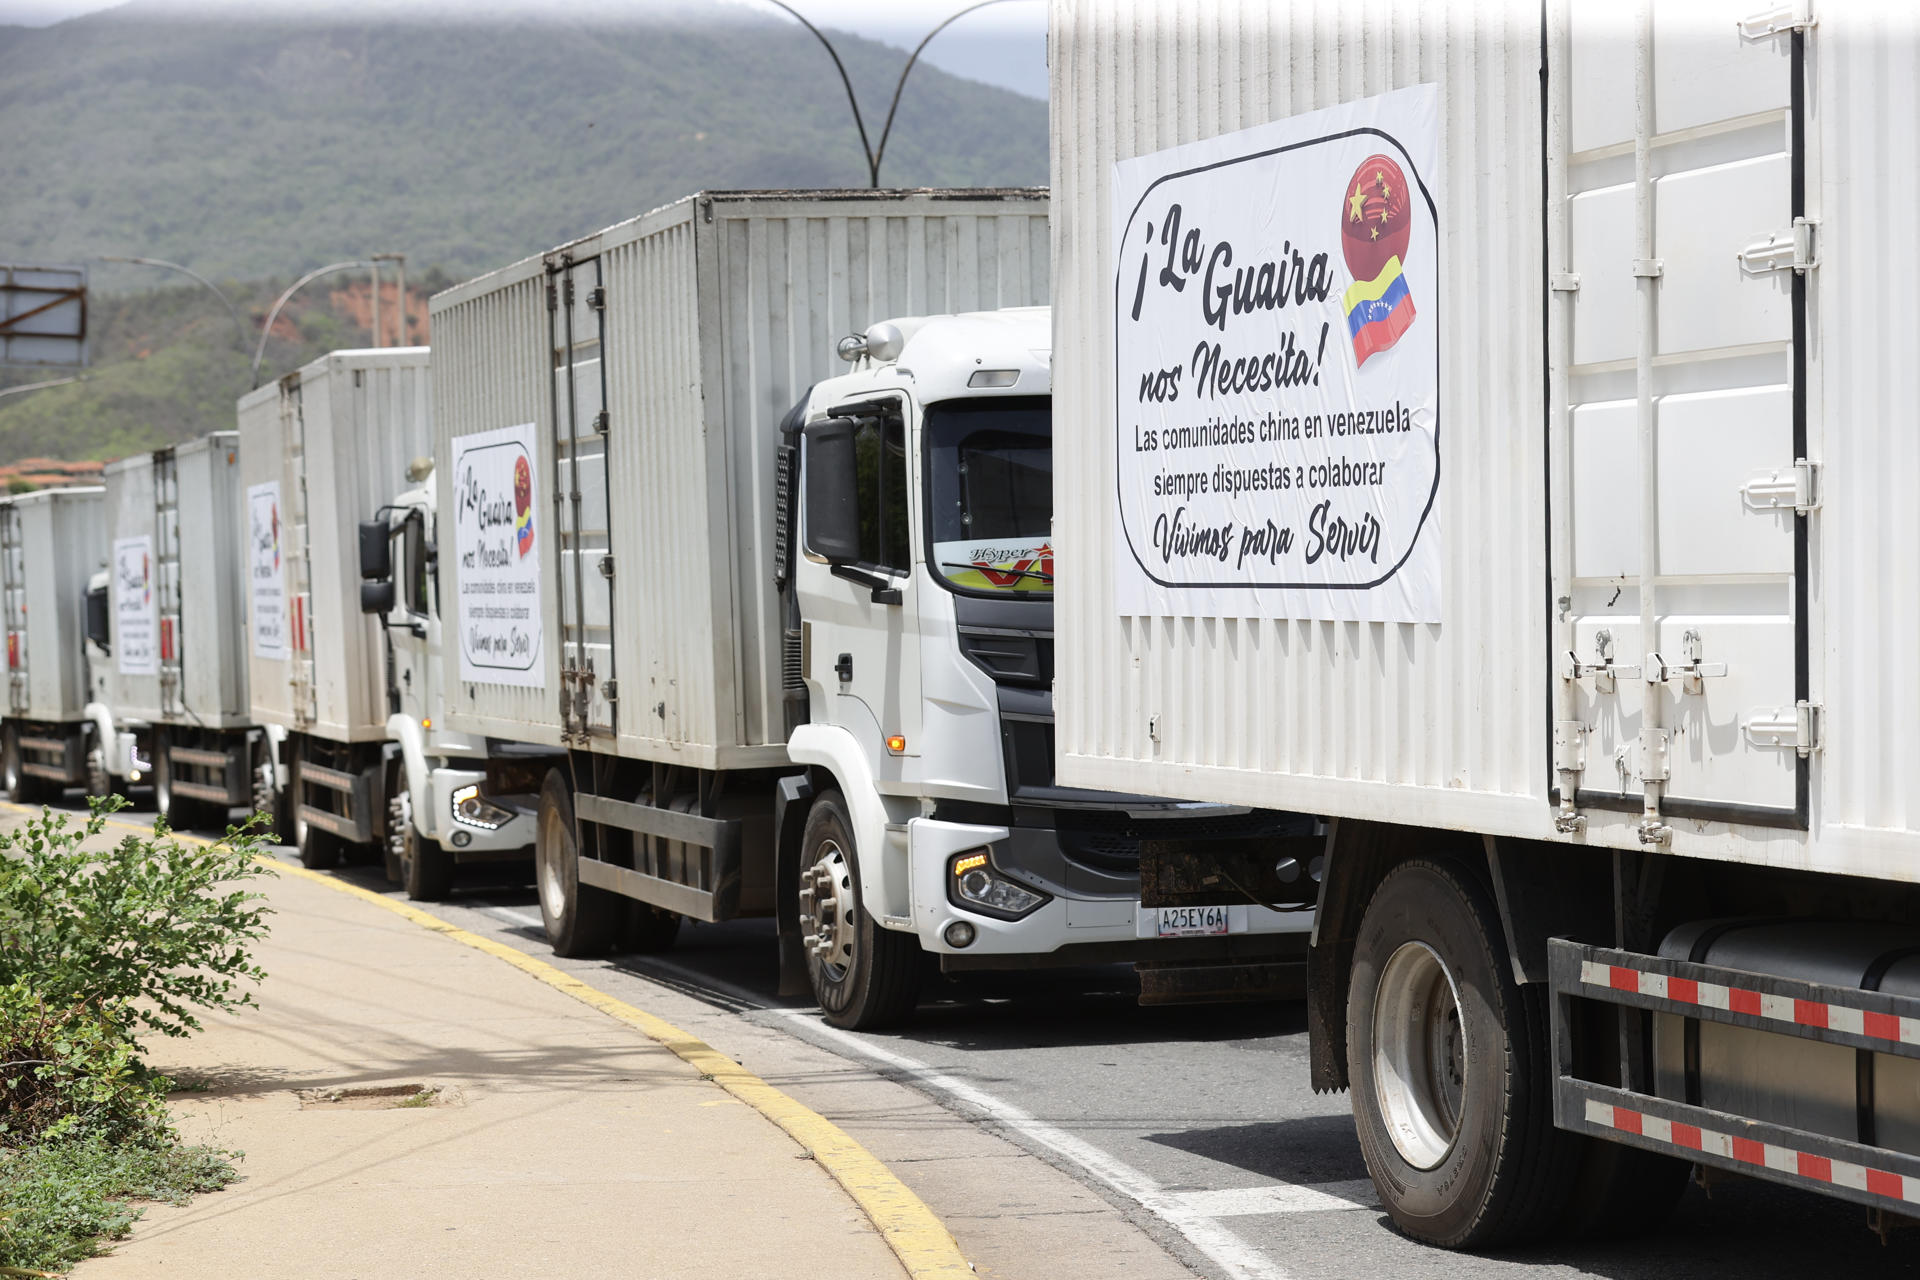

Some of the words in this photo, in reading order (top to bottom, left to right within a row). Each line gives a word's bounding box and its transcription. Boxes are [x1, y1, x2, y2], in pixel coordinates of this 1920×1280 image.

[1131, 203, 1205, 321] ¡La
[1203, 240, 1333, 331] Guaira
[1139, 365, 1182, 403] nos
[1192, 322, 1329, 400] Necesita!
[1136, 425, 1157, 451] Las
[1163, 416, 1254, 449] comunidades
[1260, 412, 1299, 442] china
[1305, 416, 1322, 438] en
[1327, 401, 1410, 436] venezuela
[1155, 473, 1208, 501] siempre
[1213, 462, 1290, 499] dispuestas
[1296, 466, 1303, 488] a
[1309, 456, 1385, 488] colaborar
[970, 548, 1031, 563] Hyper
[1154, 507, 1233, 563] Vivimos
[1237, 519, 1294, 570] para
[1306, 499, 1380, 564] Servir
[1163, 907, 1223, 928] A25EY6A
